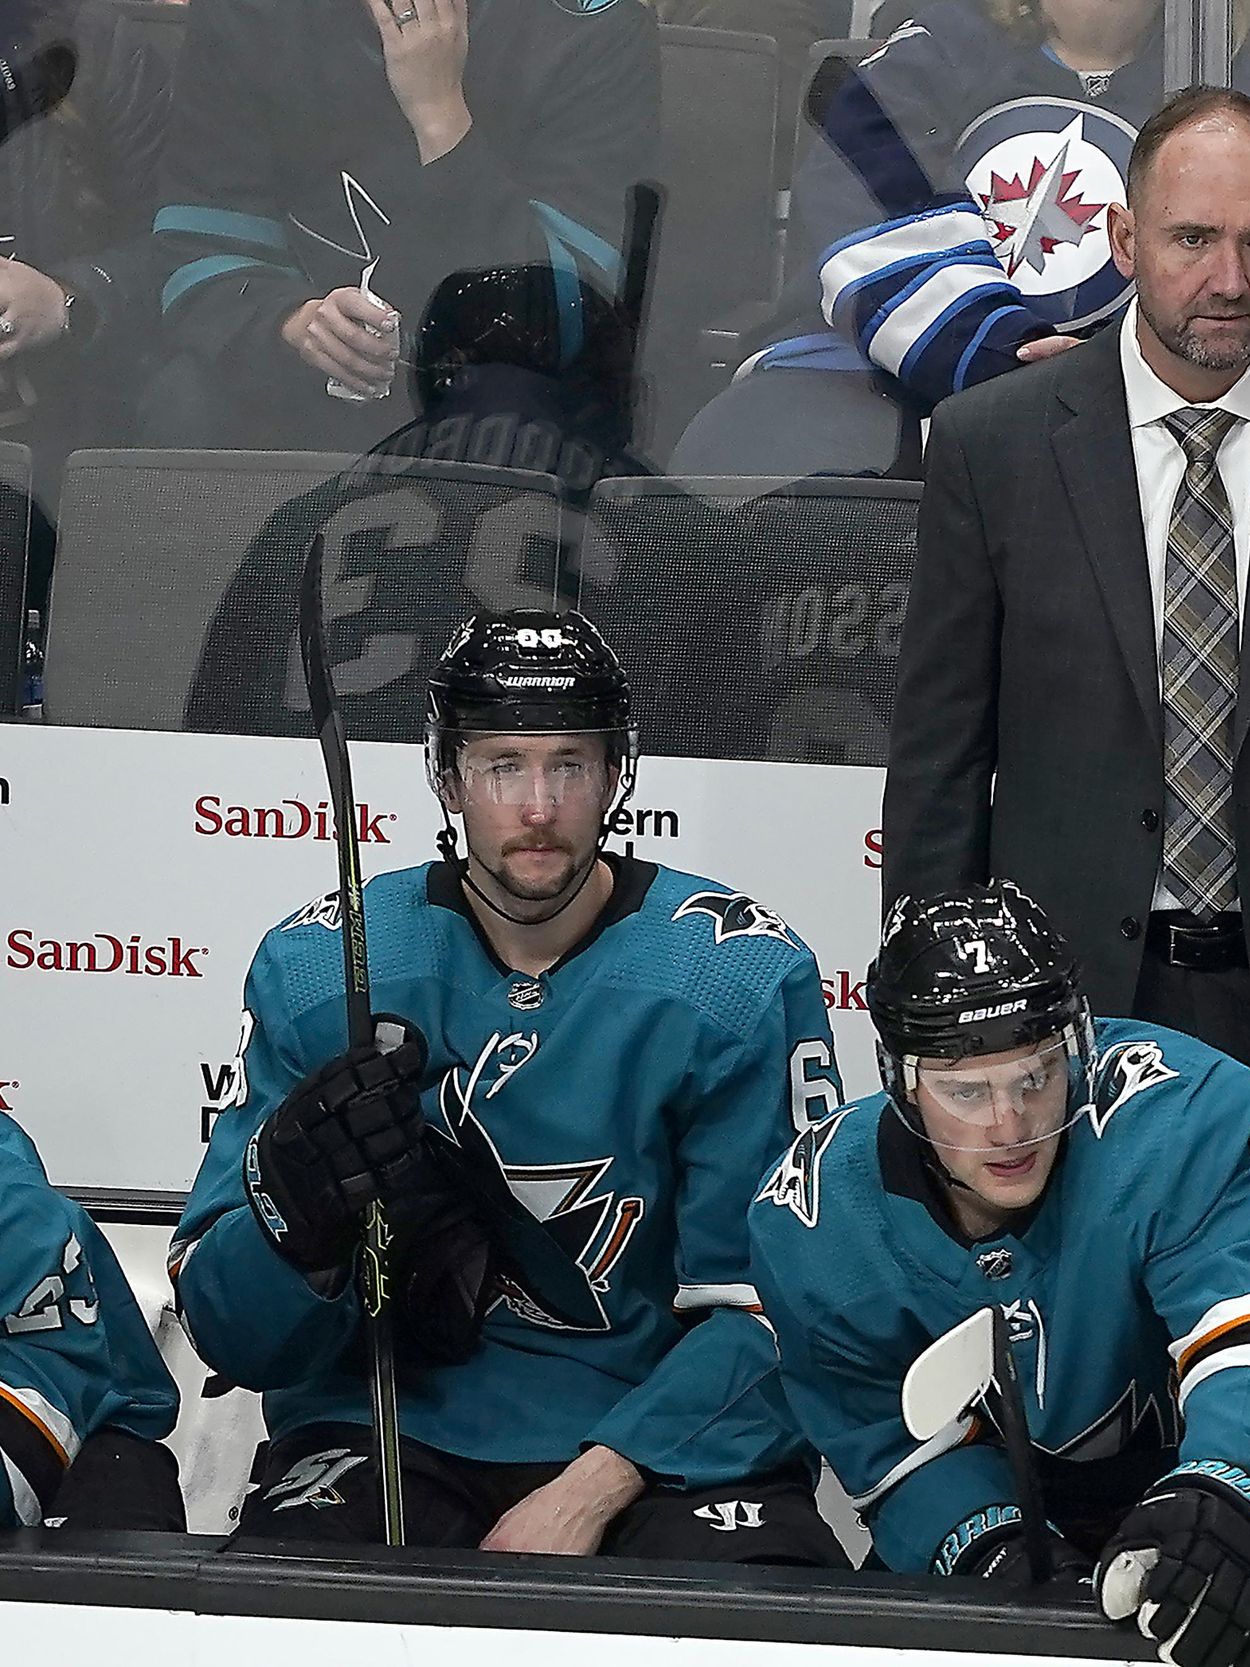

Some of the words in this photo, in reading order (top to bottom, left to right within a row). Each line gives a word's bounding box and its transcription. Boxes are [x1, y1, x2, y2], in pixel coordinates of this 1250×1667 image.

[505, 676, 576, 688] WARRIOR
[6, 930, 203, 978] SanDisk
[963, 940, 990, 974] 7
[958, 998, 1028, 1024] BAUER
